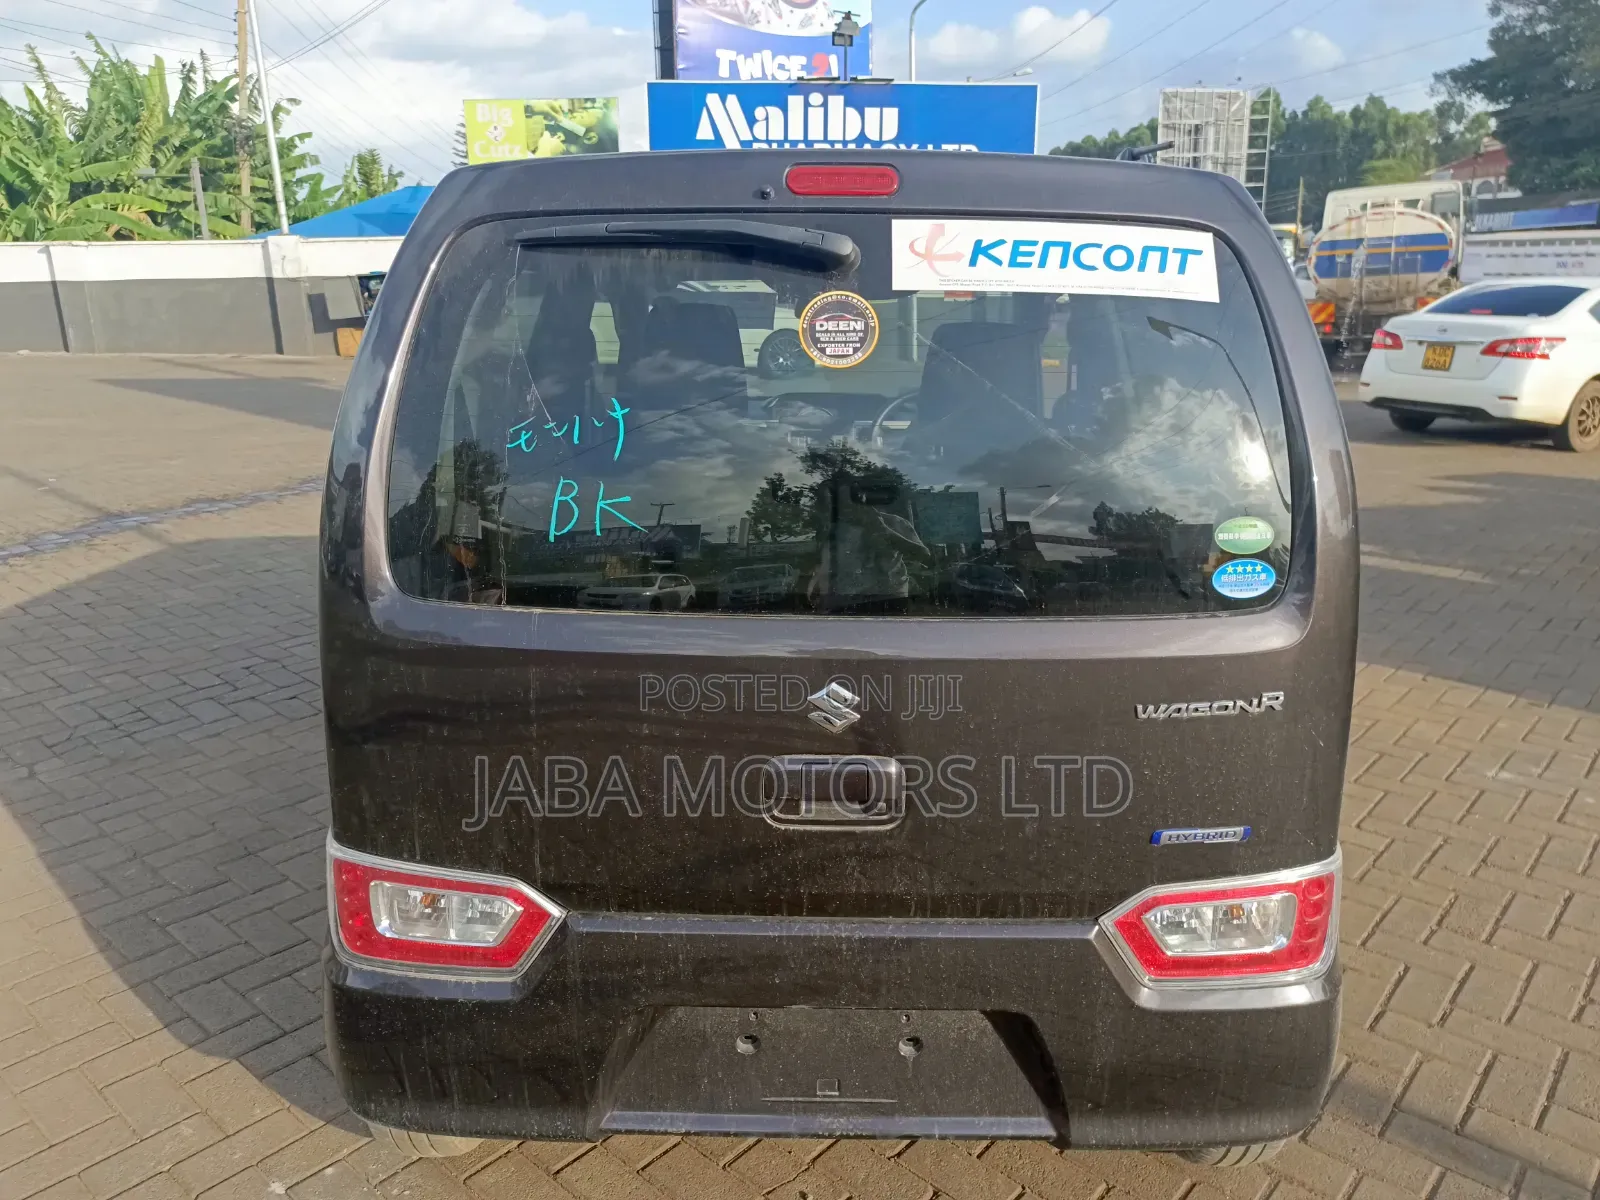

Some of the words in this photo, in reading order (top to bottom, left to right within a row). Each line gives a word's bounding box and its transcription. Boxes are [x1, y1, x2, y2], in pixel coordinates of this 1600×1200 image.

[715, 48, 807, 80] TWICE
[476, 103, 513, 127] Big
[695, 92, 899, 149] Malibu
[474, 140, 522, 158] Cutz
[1167, 829, 1238, 842] HYBRID
